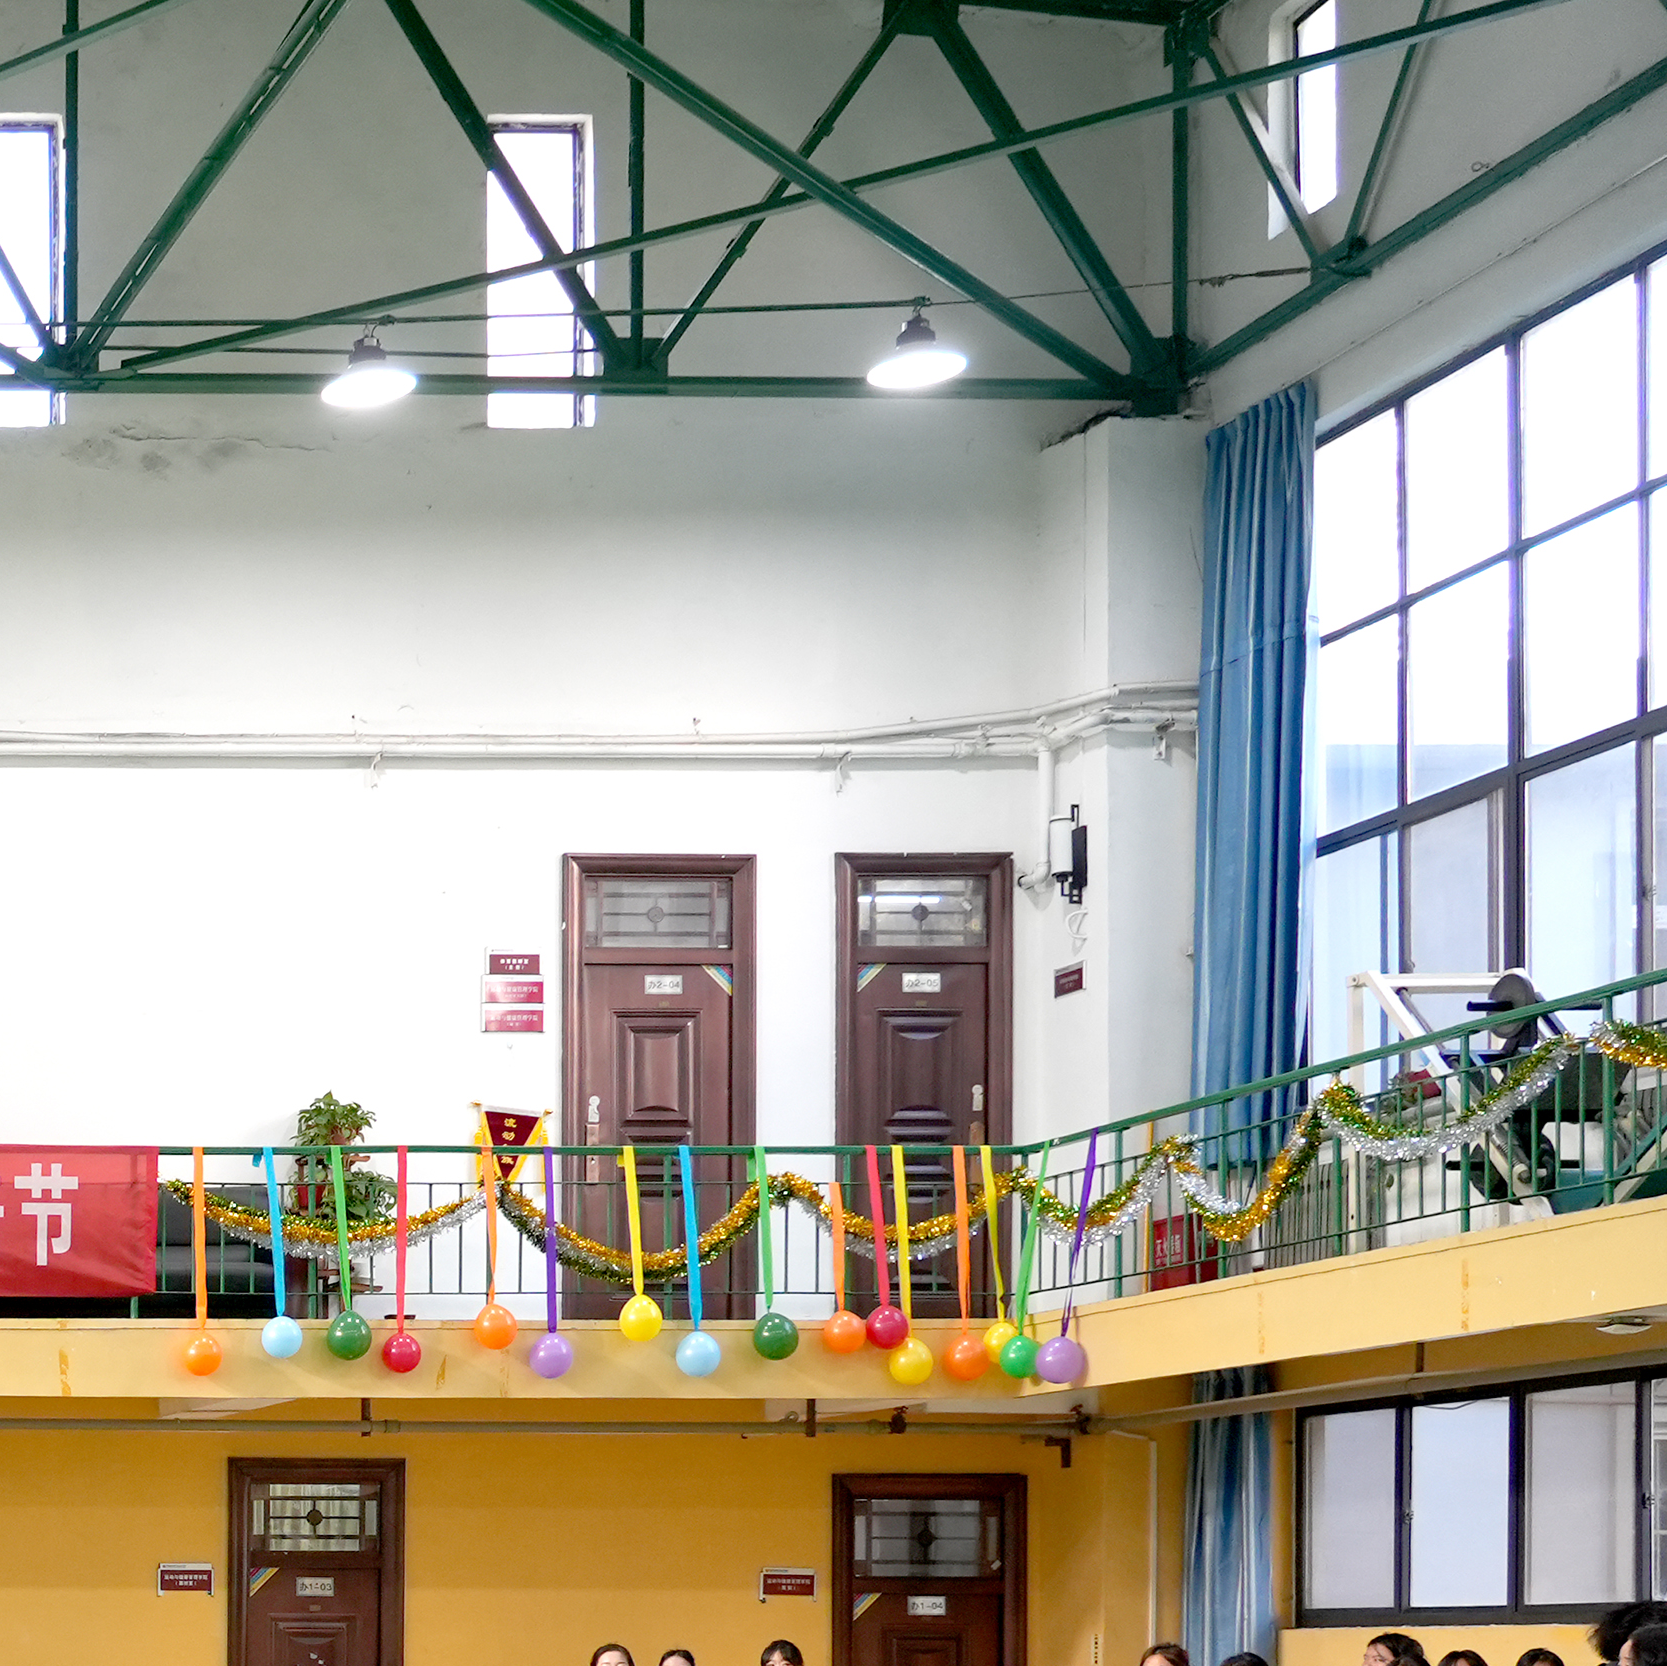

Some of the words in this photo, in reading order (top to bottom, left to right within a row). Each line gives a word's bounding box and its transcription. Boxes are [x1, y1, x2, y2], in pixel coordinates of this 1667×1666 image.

[501, 1118, 517, 1164] 流动旗
[911, 1603, 943, 1611] 办1-04
